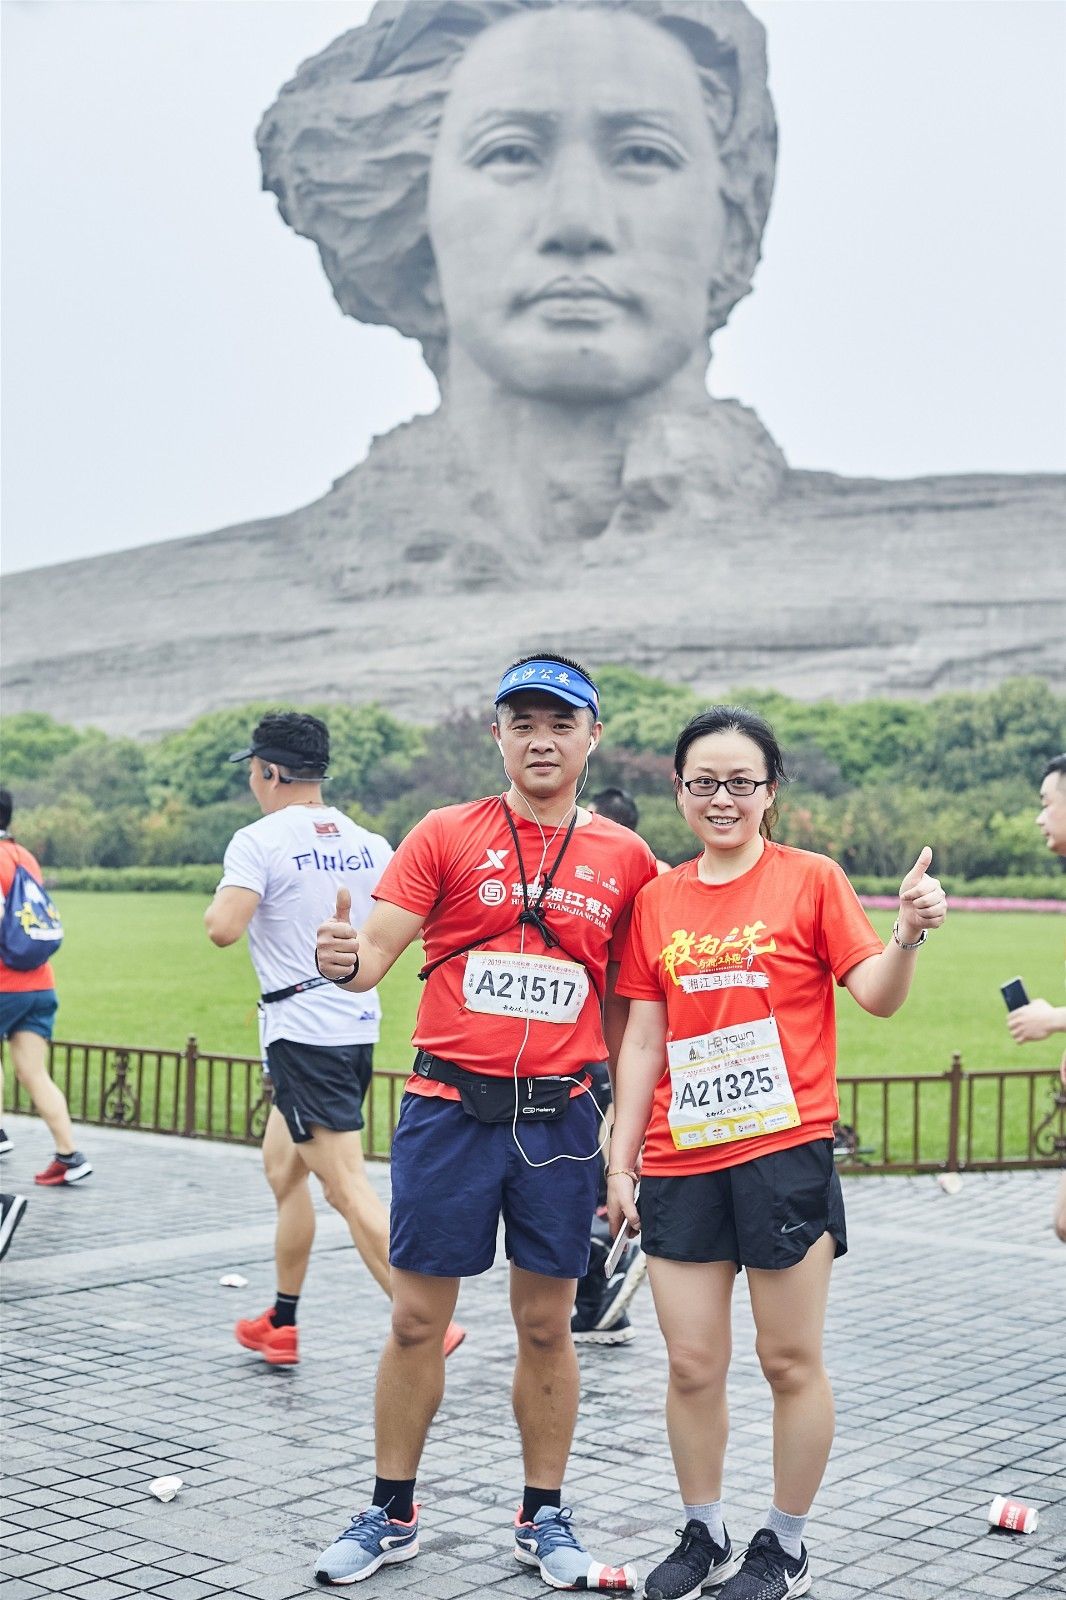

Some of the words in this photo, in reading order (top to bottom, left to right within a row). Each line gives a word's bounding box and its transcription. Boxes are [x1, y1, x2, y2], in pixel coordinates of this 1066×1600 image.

[508, 667, 571, 687] 长沙公安
[475, 969, 576, 1007] A21517
[687, 973, 757, 990] 湘江马拉松赛
[679, 1066, 774, 1110] A21325
